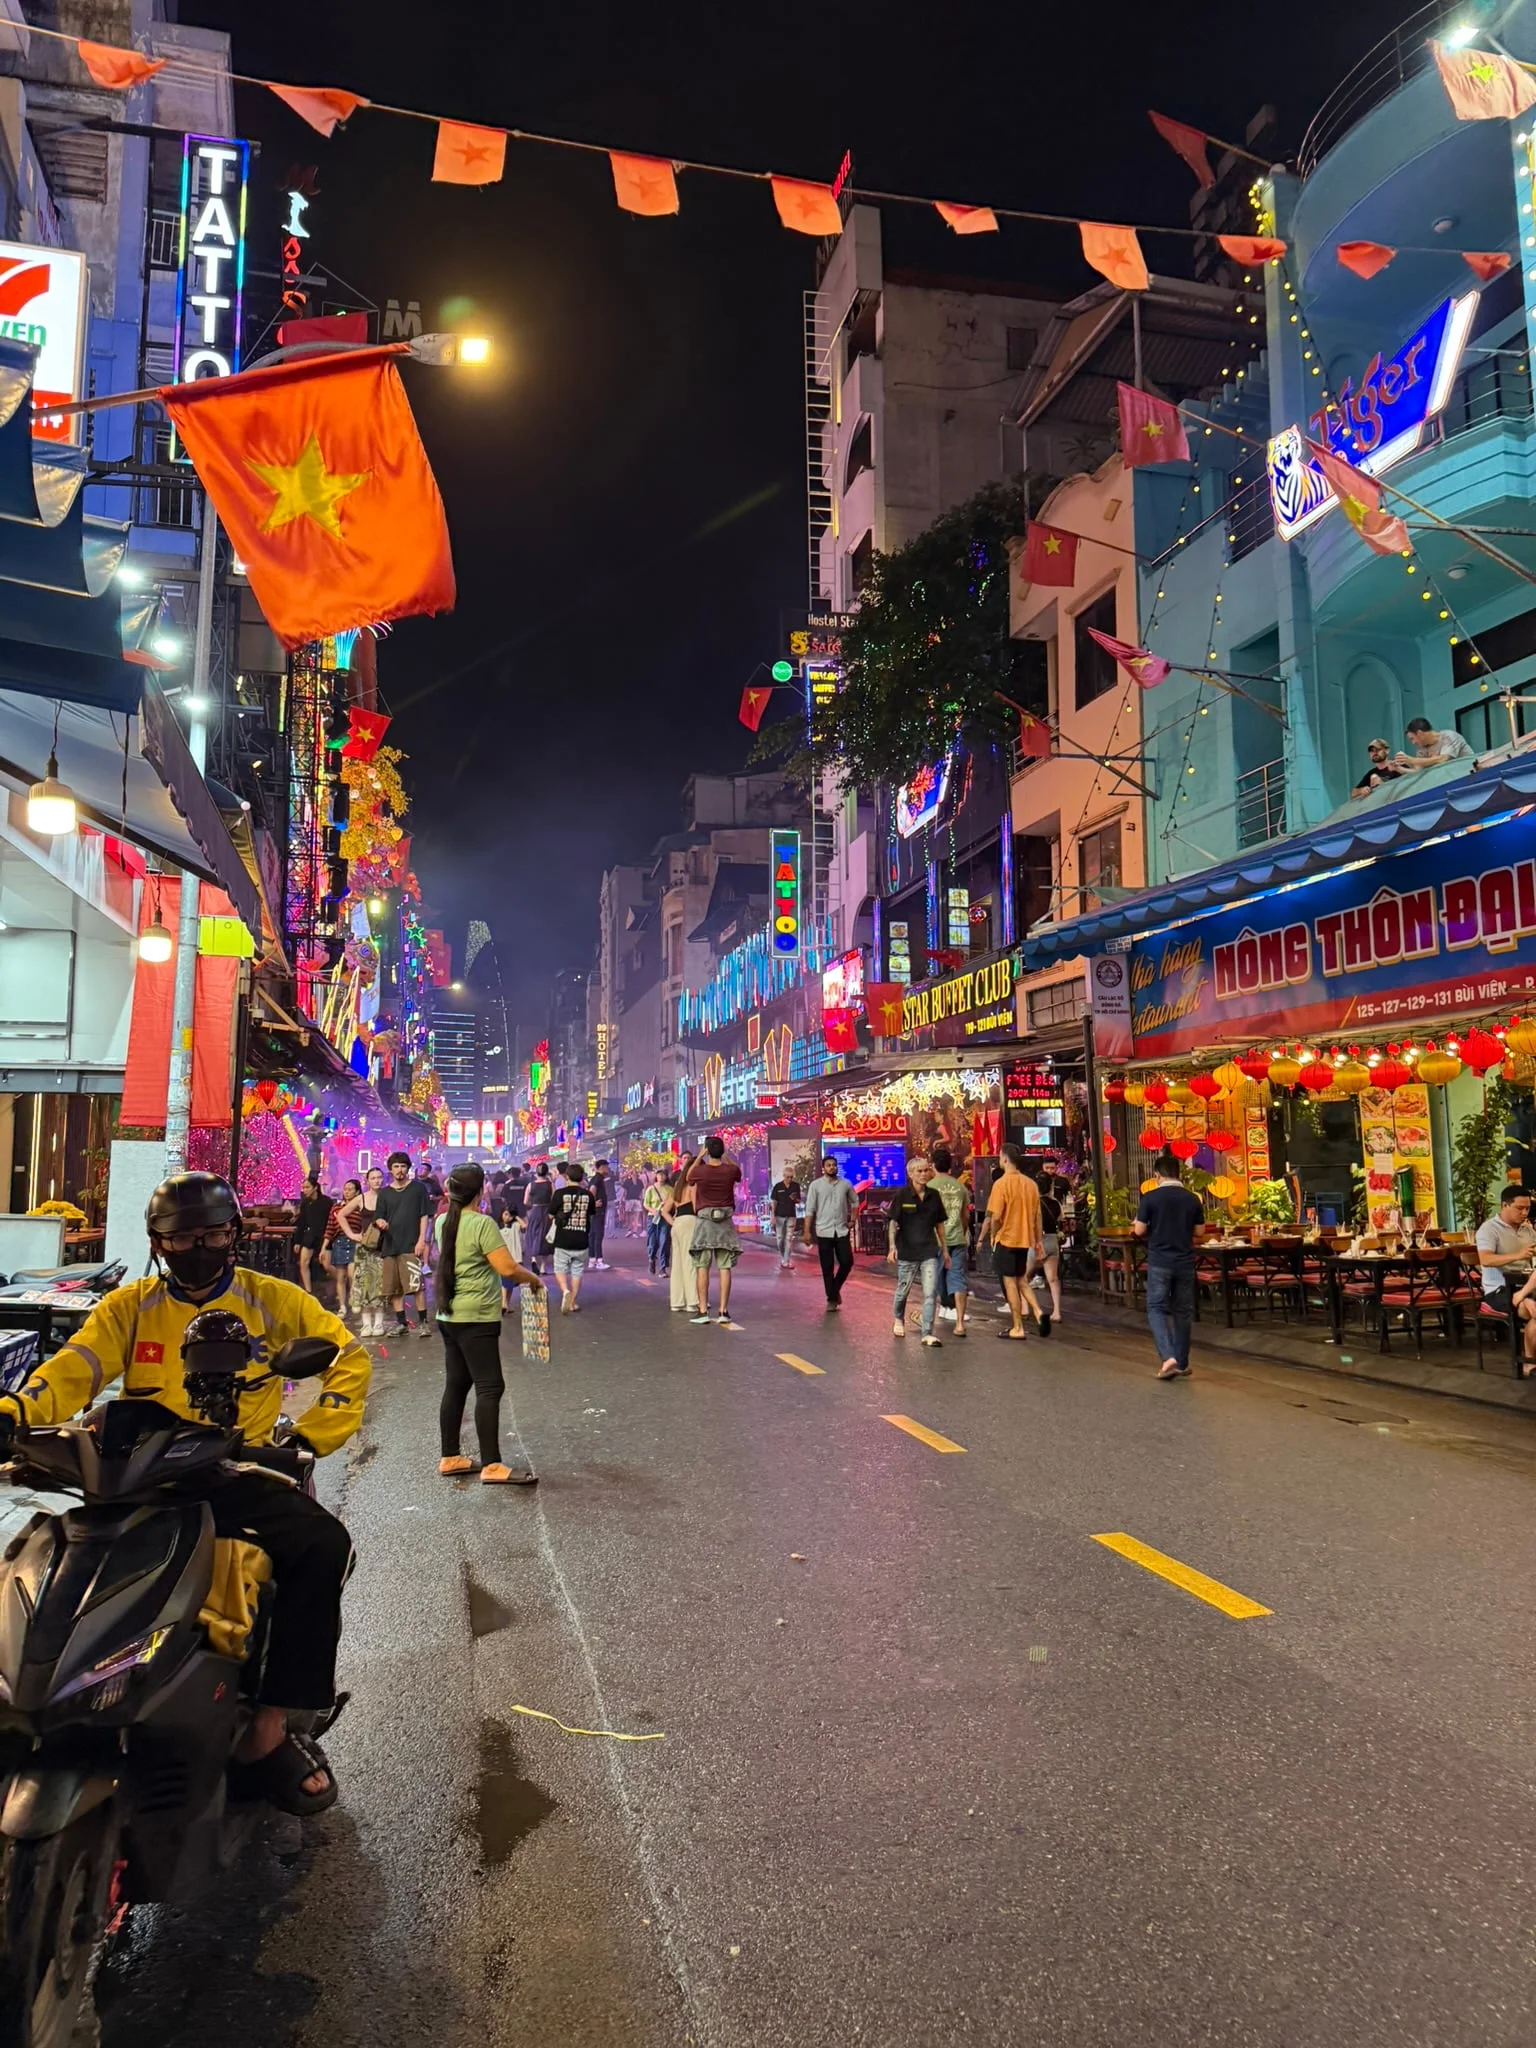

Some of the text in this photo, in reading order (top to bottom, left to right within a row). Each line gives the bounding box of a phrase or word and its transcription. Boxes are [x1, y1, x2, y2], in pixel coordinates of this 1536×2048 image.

[1309, 335, 1427, 453] Tiger
[808, 613, 838, 627] Hostel
[775, 844, 797, 952] TATTOO
[1159, 936, 1206, 984] hàng
[1213, 926, 1313, 1001] NÔNG
[1315, 885, 1440, 978] THÔN
[931, 972, 974, 1022] BUFFET
[975, 959, 1011, 1006] CLUB
[1132, 977, 1208, 1035] estaurant
[597, 1033, 606, 1080] HOTEL
[821, 1116, 851, 1133] ALL
[855, 1114, 892, 1131] YOU
